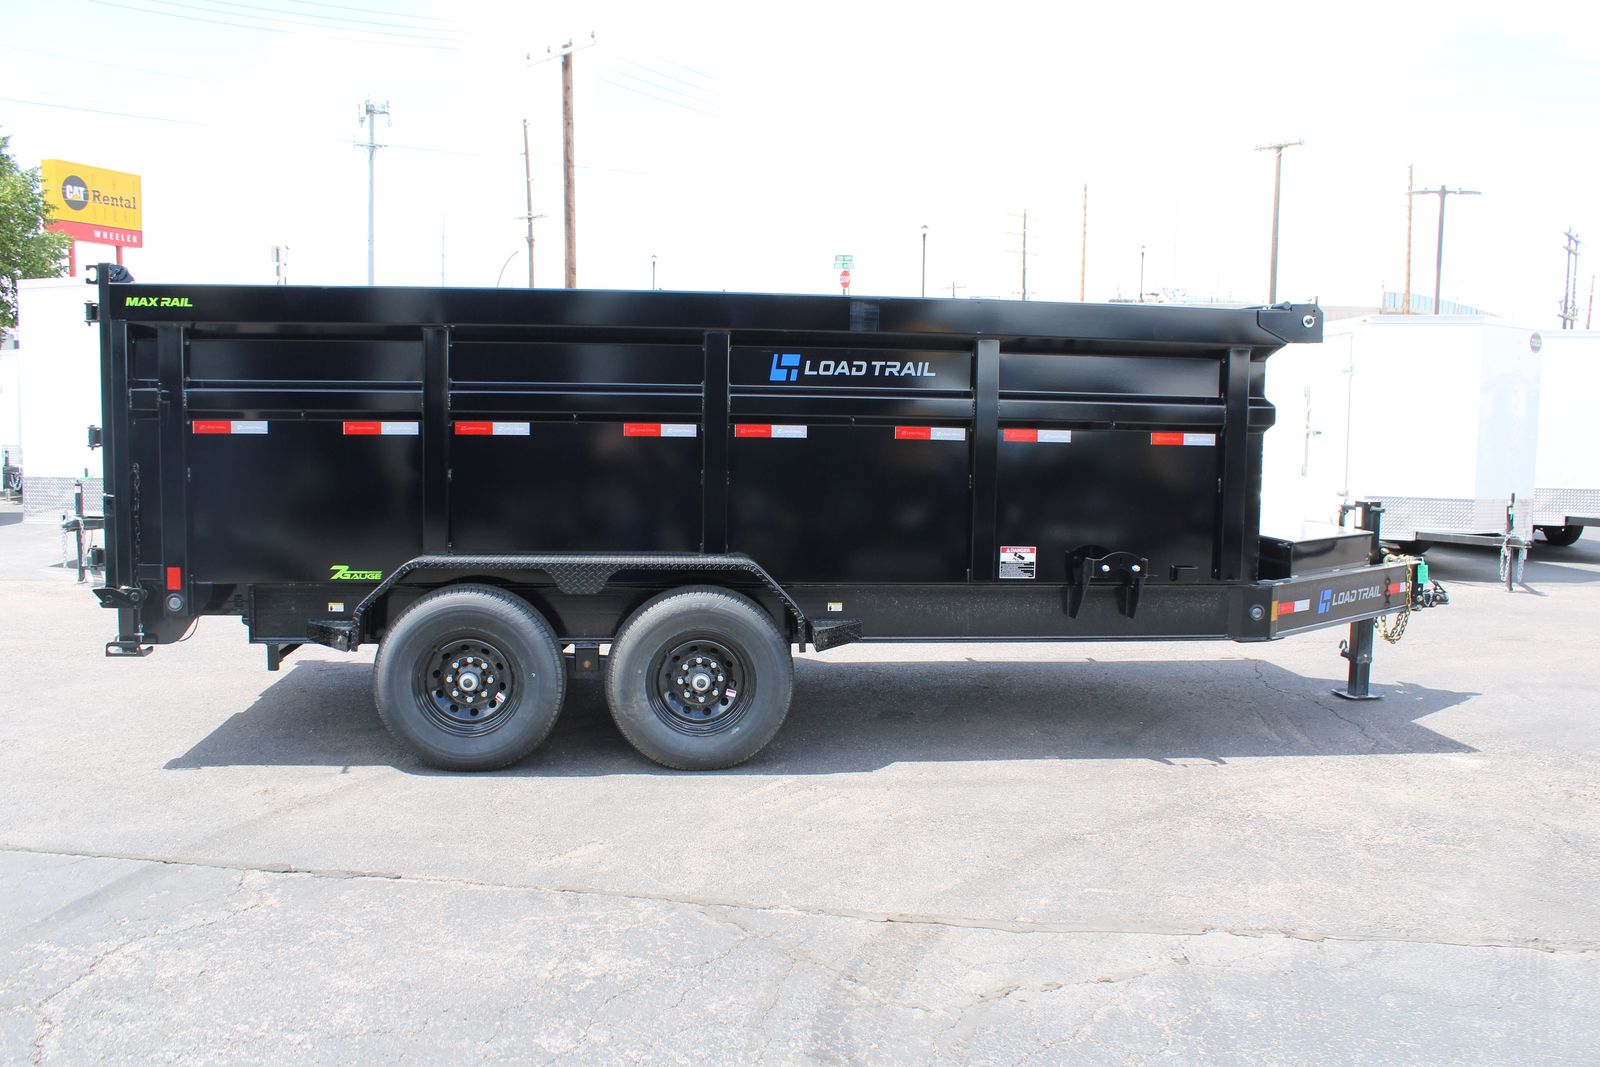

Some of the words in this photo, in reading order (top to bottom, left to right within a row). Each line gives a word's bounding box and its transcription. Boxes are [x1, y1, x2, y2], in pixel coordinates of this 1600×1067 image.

[65, 184, 86, 201] CAT
[92, 189, 137, 209] Rental
[93, 230, 138, 243] WHEELER
[125, 296, 159, 307] MAX
[160, 297, 194, 308] RAIL
[804, 360, 868, 376] LOAD
[871, 361, 937, 377] TRAIL
[1332, 589, 1357, 606] LOAD
[1358, 585, 1382, 601] TRAIL
